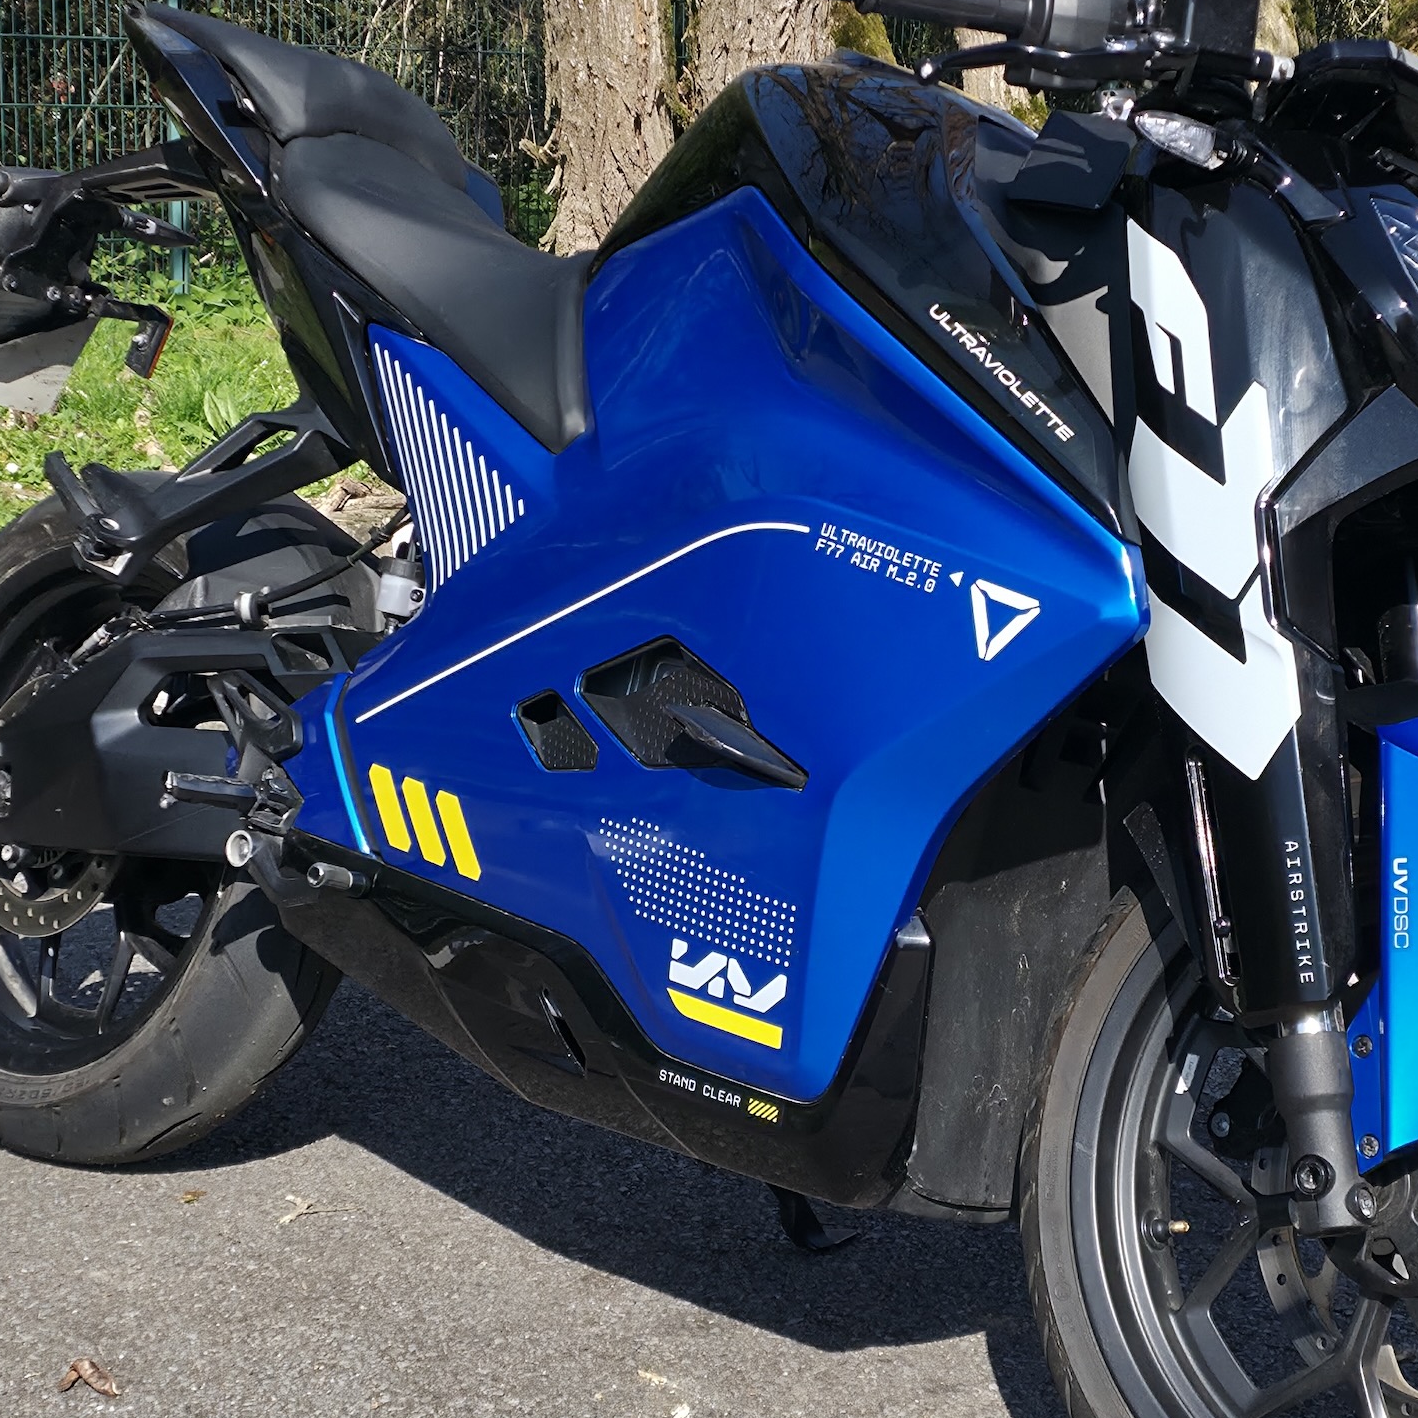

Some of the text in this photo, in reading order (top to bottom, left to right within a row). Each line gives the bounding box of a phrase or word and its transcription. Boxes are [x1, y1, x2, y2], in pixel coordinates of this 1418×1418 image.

[929, 304, 1075, 442] ULTRAVIOLETTE
[815, 540, 937, 593] F77 AIR M_2.0
[821, 523, 942, 578] ULTRAVIOLETTE
[1284, 840, 1314, 984] AIRSTRIKE
[659, 1069, 741, 1108] STAND CLEAR
